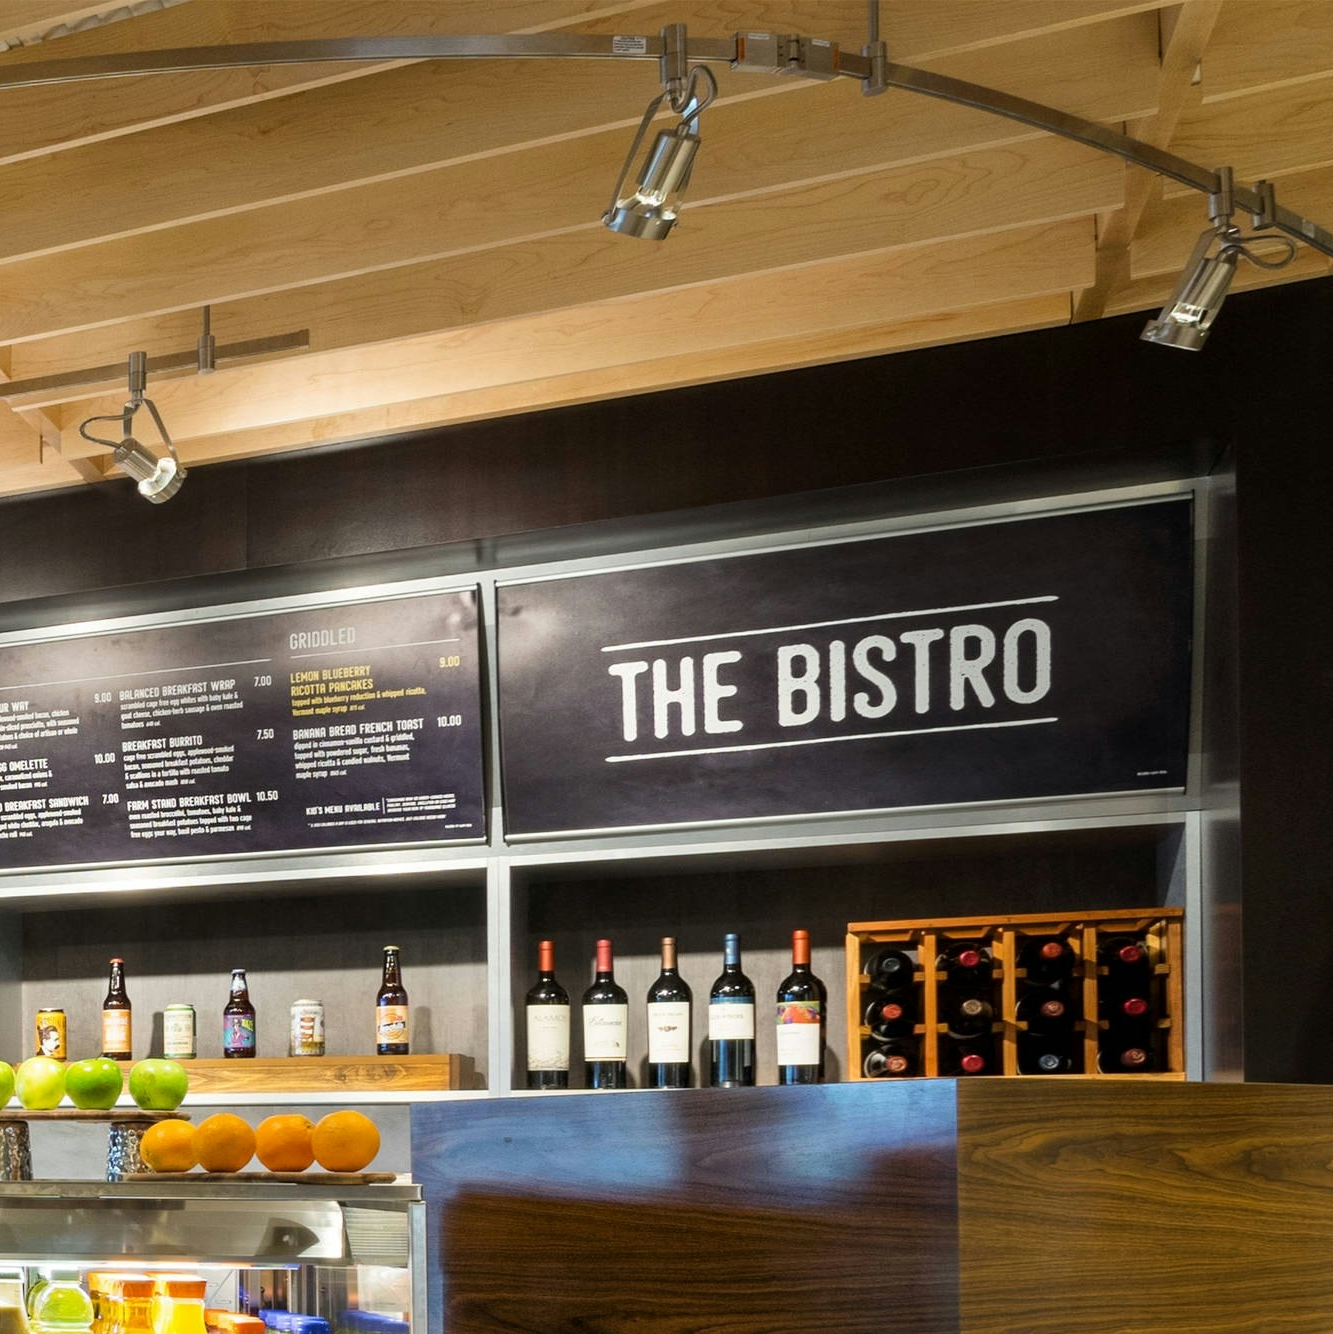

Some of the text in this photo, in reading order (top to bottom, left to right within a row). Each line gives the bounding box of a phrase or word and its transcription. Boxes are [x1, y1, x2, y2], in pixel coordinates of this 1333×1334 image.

[289, 627, 356, 650] GRIDDLED
[290, 655, 460, 683] LEMON BLUEBERRY 9.00
[608, 618, 1052, 742] THE BISTRO
[118, 675, 272, 701] BALANCED BREAKFAST WRAP 7.00
[290, 678, 373, 696] RICOTTA PANCAKES
[10, 700, 29, 712] WAY
[292, 714, 462, 740] BANANA BREAD FRENCH TOAST 10.00
[121, 728, 274, 752] BREAKFAST BURRITO 7.50
[8, 758, 48, 771] OMELETTE
[94, 752, 115, 764] 10.00
[4, 798, 46, 812] BREAKFAST
[48, 795, 89, 808] SANDWICH
[102, 793, 119, 804] 7.00
[126, 790, 278, 811] FARM STAND BREAKFAST BOWL 10.50
